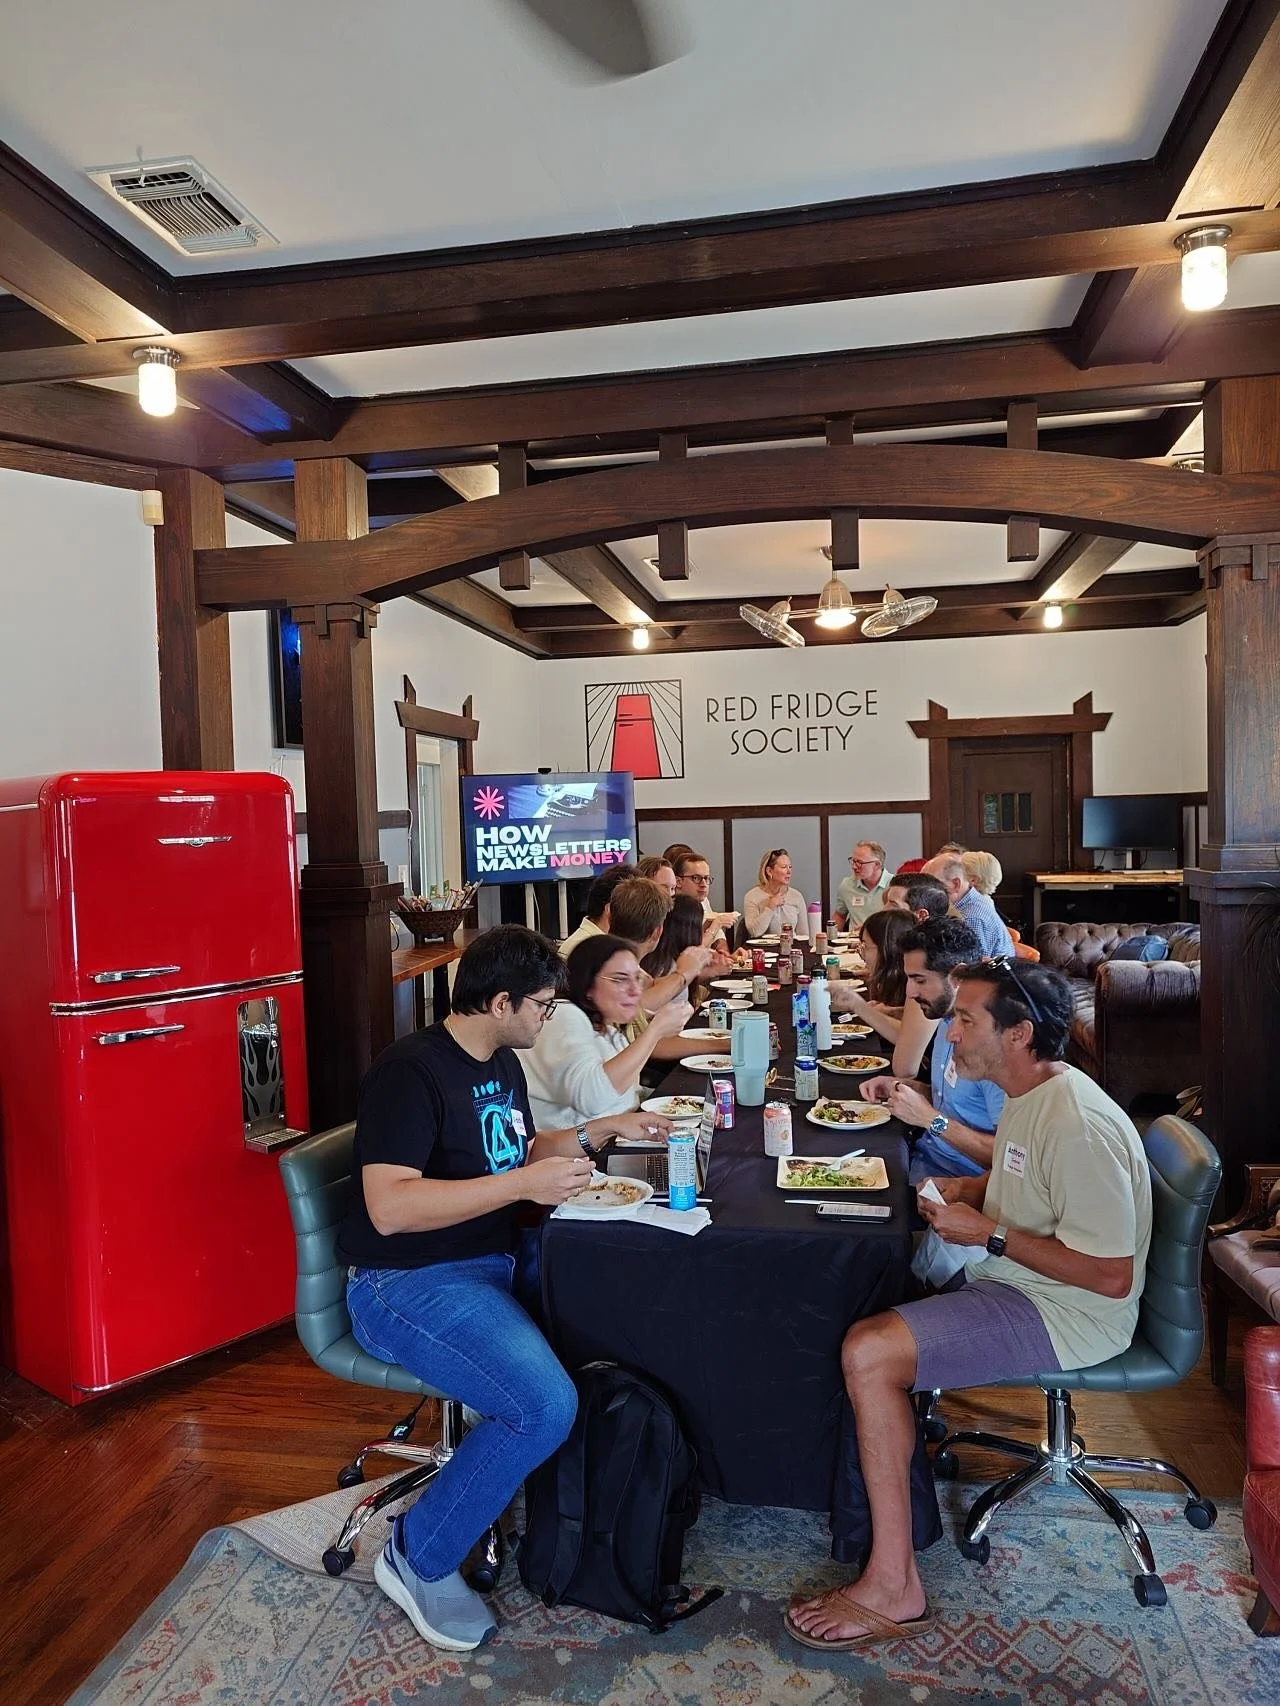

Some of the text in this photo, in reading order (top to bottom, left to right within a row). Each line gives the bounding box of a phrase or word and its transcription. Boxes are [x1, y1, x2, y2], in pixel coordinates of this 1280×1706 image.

[706, 689, 878, 723] RED FRIDGE
[730, 725, 853, 755] SOCIETY
[475, 824, 552, 846] HOW
[476, 838, 632, 860] NEWSLETTERS
[477, 850, 629, 872] MAKE MONEY
